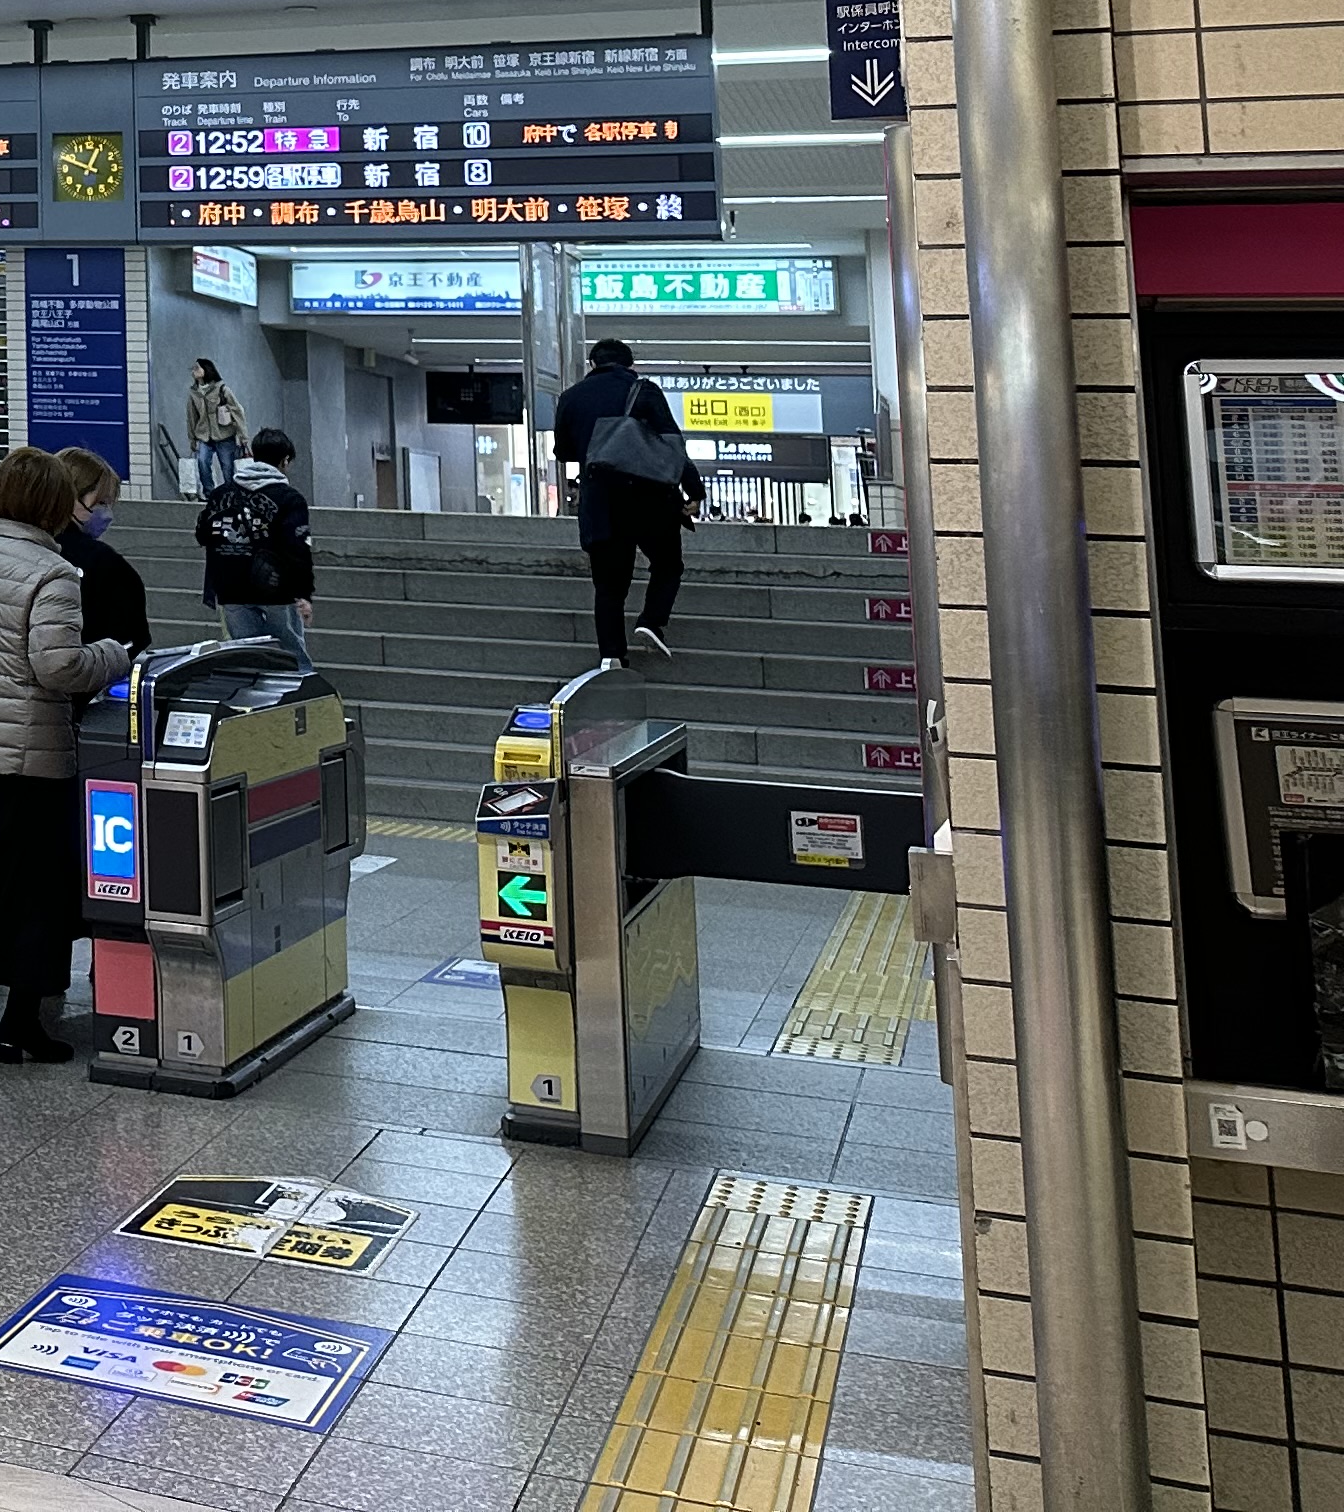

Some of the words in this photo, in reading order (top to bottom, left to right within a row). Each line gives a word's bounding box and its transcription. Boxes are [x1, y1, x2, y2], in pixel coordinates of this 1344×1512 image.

[843, 38, 901, 52] Intercom
[445, 55, 483, 69] 明大前
[665, 49, 687, 61] 方面
[162, 71, 237, 90] 発車案内
[254, 75, 309, 88] Departure
[313, 73, 376, 85] Information
[162, 104, 191, 115] のりば
[197, 103, 241, 115] 発車時刻
[337, 99, 359, 111] 行先
[163, 118, 187, 126] Track
[197, 117, 235, 126] Departure
[263, 115, 287, 124] Train
[337, 112, 349, 122] To
[463, 108, 489, 118] Cars
[196, 131, 265, 154] 12:52
[196, 167, 265, 189] 12:59
[66, 254, 79, 286] 1
[388, 272, 482, 288] 京王不動産
[690, 398, 728, 416] 出口
[93, 814, 132, 854] IC
[98, 884, 130, 896] KEIO
[504, 929, 541, 941] KEIO
[121, 1030, 136, 1047] 2
[183, 1033, 194, 1050] 1
[541, 1078, 553, 1097] 1
[39, 1324, 61, 1333] Tap
[81, 1333, 108, 1342] ride
[111, 1338, 142, 1348] with
[143, 1345, 176, 1355] your
[178, 1351, 264, 1371] smartphone
[81, 1346, 138, 1363] VISA
